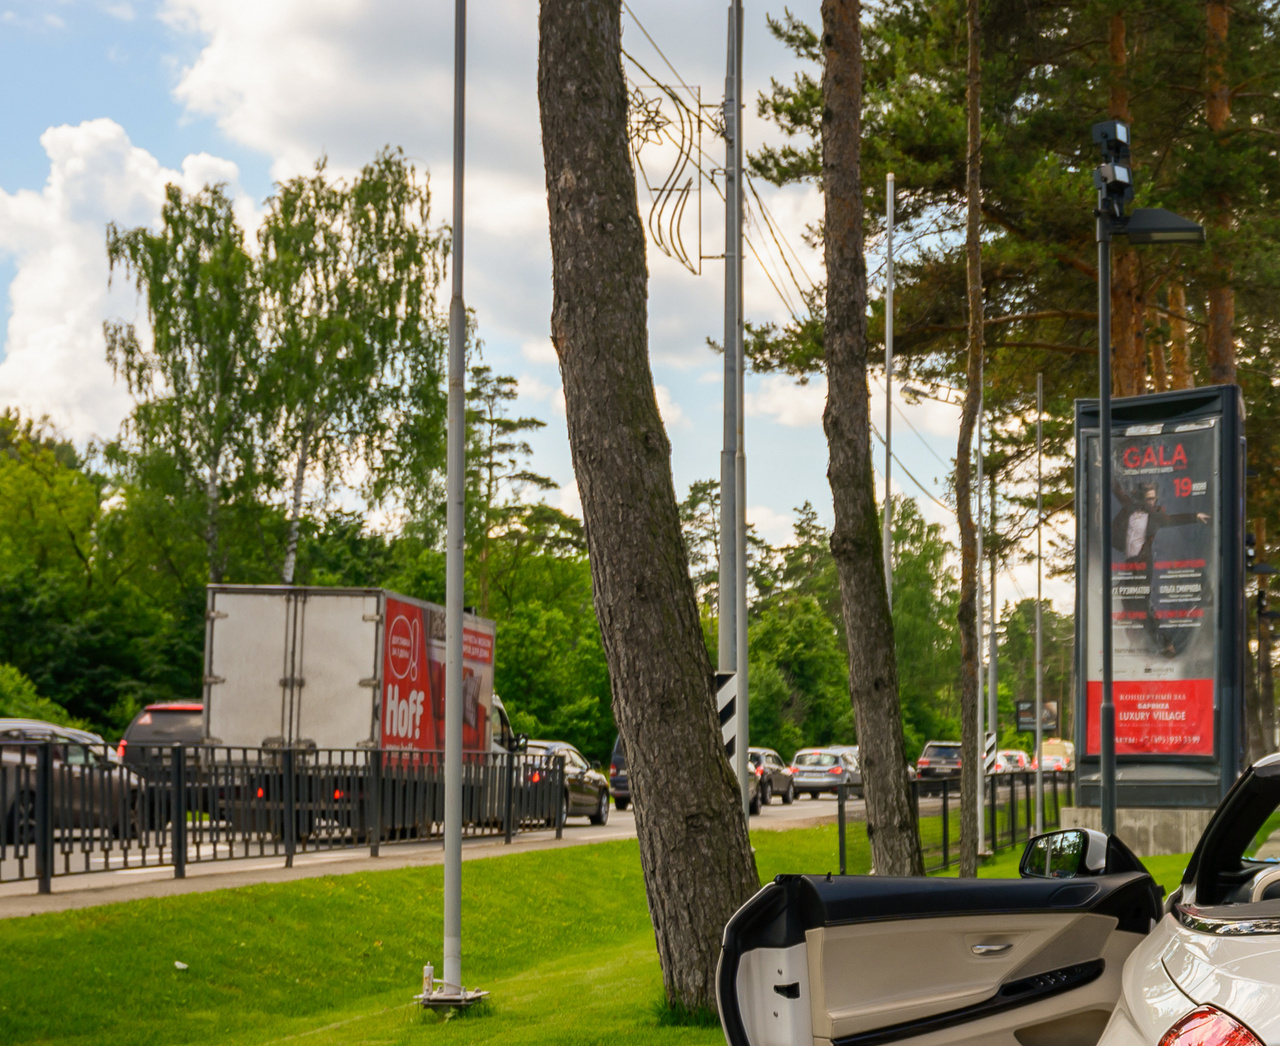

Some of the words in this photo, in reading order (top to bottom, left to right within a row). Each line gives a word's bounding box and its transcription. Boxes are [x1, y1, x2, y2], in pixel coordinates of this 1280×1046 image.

[1123, 443, 1188, 468] GALA
[1173, 477, 1192, 497] 19
[1119, 693, 1172, 701] КОНЦЕРТНЫЙ
[1119, 711, 1151, 721] LUXURY
[1152, 711, 1187, 721] VILLAGE
